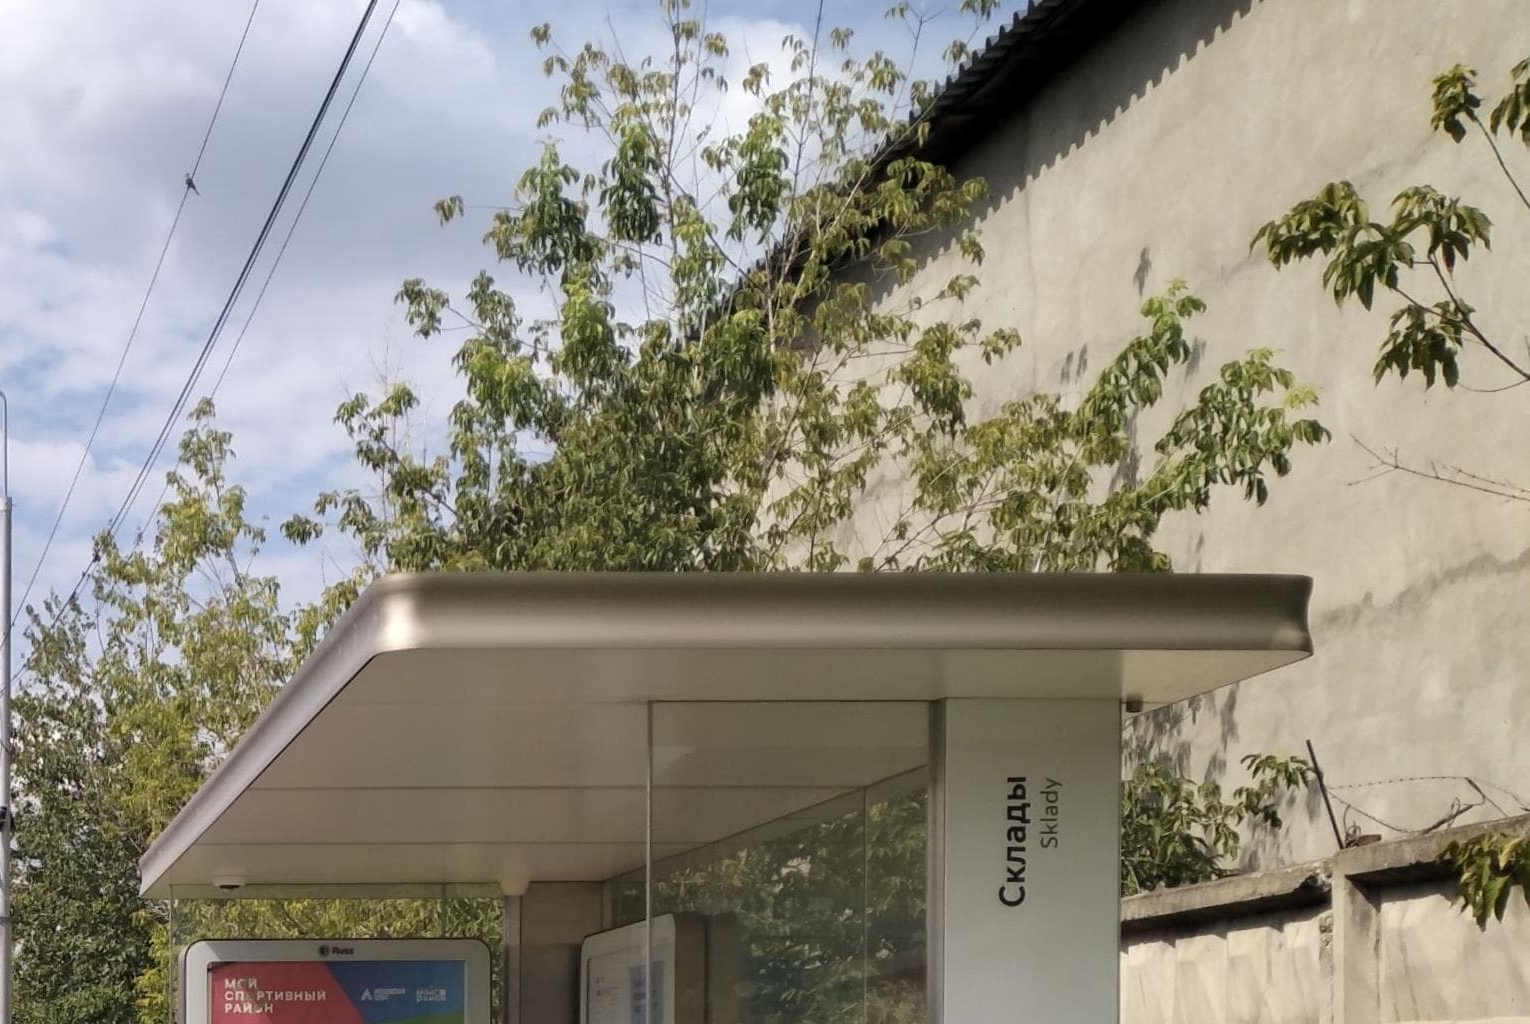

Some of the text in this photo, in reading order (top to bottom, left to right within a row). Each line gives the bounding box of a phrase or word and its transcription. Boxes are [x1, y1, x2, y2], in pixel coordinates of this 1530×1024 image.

[999, 776, 1031, 907] Склады
[1040, 777, 1063, 848] Sklady
[224, 1001, 274, 1014] РАЙОН
